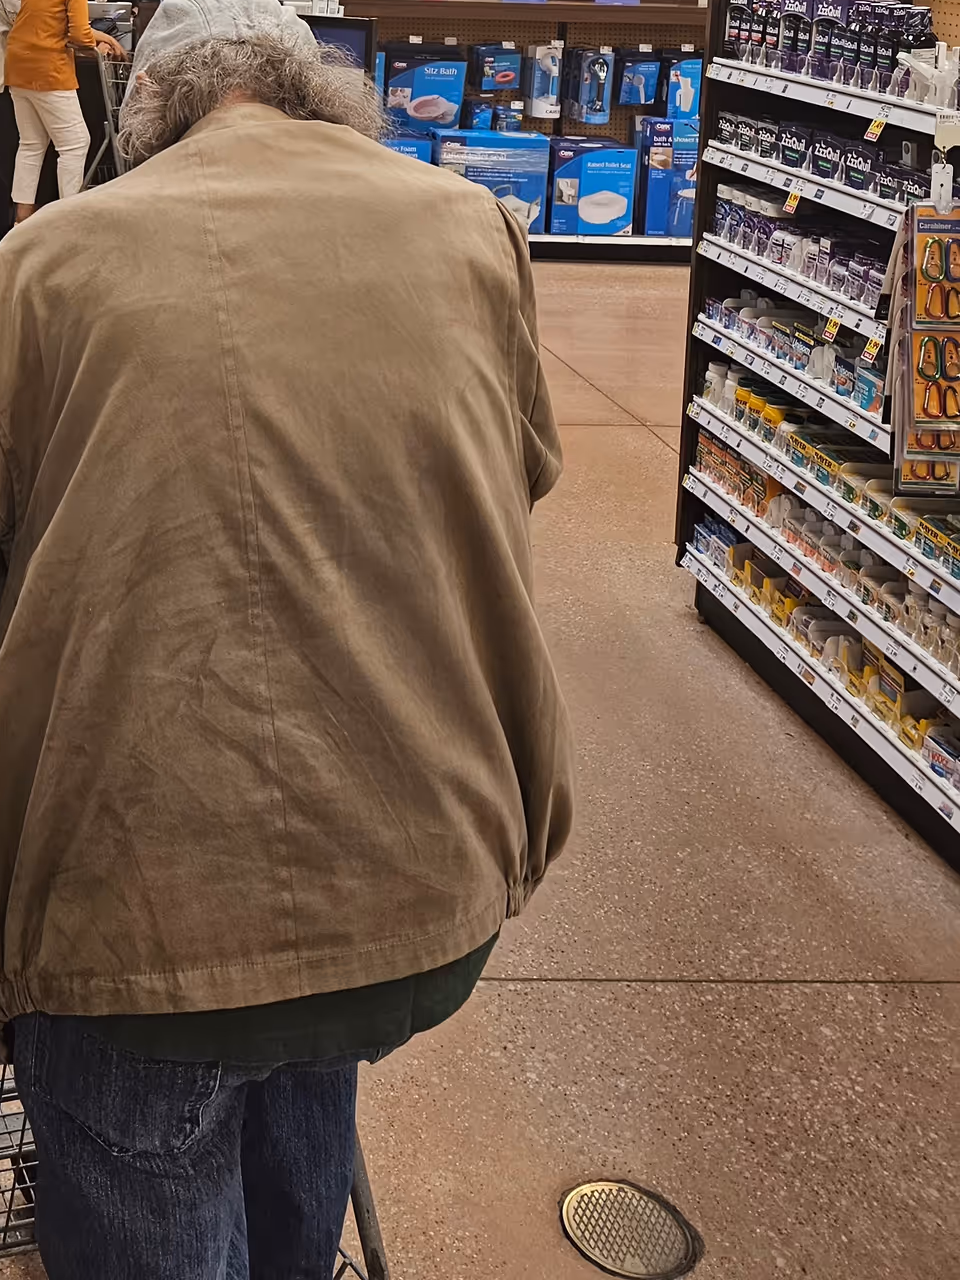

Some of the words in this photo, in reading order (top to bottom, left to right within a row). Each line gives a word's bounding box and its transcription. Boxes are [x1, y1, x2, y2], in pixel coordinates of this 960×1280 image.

[817, 3, 841, 18] ZzzQuil
[424, 67, 438, 75] Sitz
[439, 67, 458, 75] Bath
[781, 132, 806, 151] ZzzQuil
[815, 141, 840, 161] ZzzQuil
[846, 151, 872, 172] ZzzQuil
